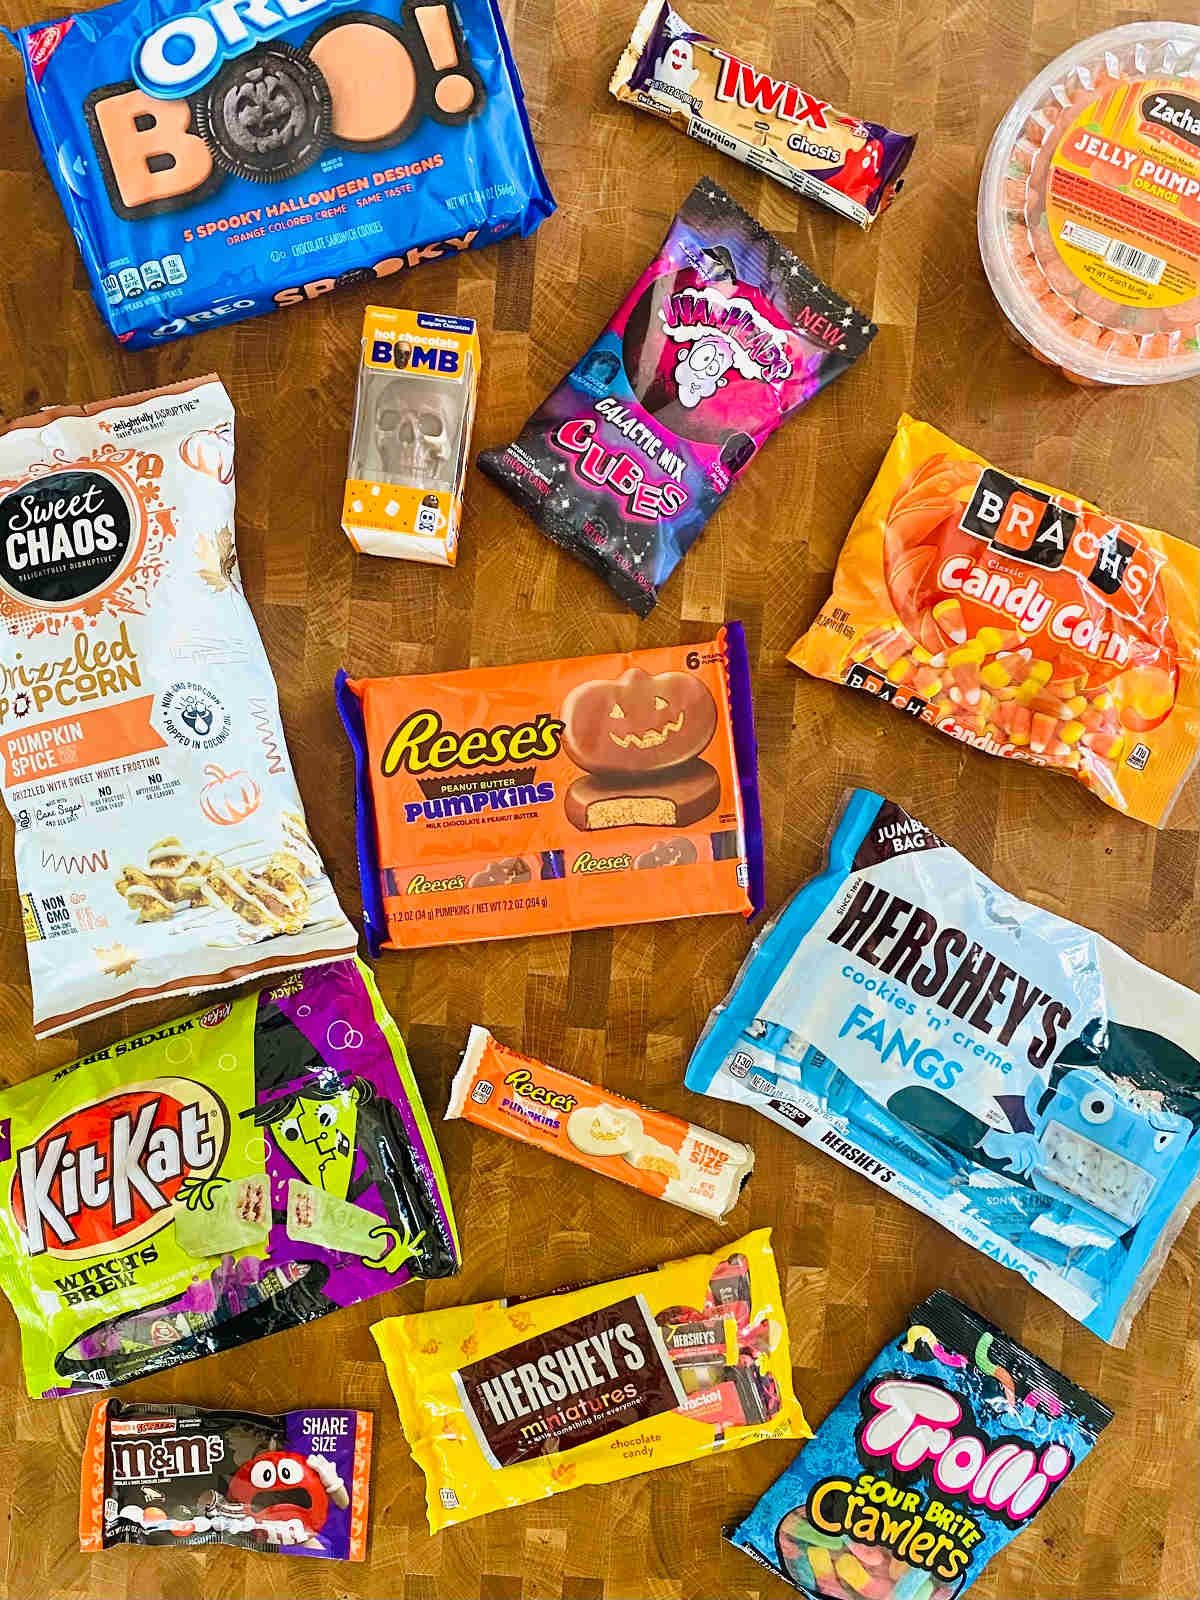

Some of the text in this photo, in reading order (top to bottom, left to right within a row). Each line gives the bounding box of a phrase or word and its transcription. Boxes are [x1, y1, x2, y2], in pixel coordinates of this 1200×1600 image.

[713, 48, 833, 132] TWIX
[692, 121, 737, 151] Nutrition
[787, 134, 841, 162] Ghosts
[1073, 133, 1138, 171] JELLY
[1139, 159, 1200, 202] PUMP
[183, 229, 194, 242] 5
[196, 208, 262, 239] SPOOKY
[266, 177, 369, 218] HALLOWEEN
[373, 154, 445, 187] DESIGNS
[356, 184, 414, 209] SAME TASTE
[1133, 178, 1179, 204] ORANGE
[226, 203, 347, 246] ORANGE COLORED CREME
[291, 221, 384, 257] CHOCOLATE SANDWICH COOKIES
[151, 299, 256, 337] OREO
[796, 304, 848, 347] NEW
[374, 328, 459, 349] hot chocolate
[371, 340, 459, 373] BOMB
[112, 411, 154, 432] delightfully
[593, 397, 688, 485] GALACTIC MIX
[553, 418, 689, 520] CUBES
[8, 484, 105, 532] Sweet
[976, 488, 1148, 597] BRACH'S
[987, 559, 1025, 578] Classic
[940, 556, 1130, 665] Candy Corn
[686, 651, 700, 670] 6
[7, 722, 84, 759] PUMPKIN
[162, 719, 191, 746] POPPED
[191, 740, 201, 750] IN
[202, 727, 230, 750] COCONUT
[381, 710, 565, 777] Reese's
[11, 748, 58, 778] SPICE
[12, 755, 161, 801] DRIZZLED WITH SWEET WHITE FROSTING
[98, 785, 112, 798] NO
[147, 773, 163, 785] NO
[441, 778, 516, 794] PEANUT BUTTER
[36, 804, 83, 822] Cane Sugar
[442, 817, 480, 828] CHOCOLATE
[486, 814, 513, 823] PEANUT
[513, 811, 540, 820] BUTTER
[891, 832, 926, 853] BAG
[572, 852, 632, 874] Reese's
[407, 874, 465, 895] Reese's
[41, 895, 66, 911] NON
[46, 908, 70, 924] GMO
[404, 911, 414, 922] OZ
[415, 910, 426, 922] (34
[434, 904, 470, 920] PUMPKINS
[476, 901, 488, 914] NET
[488, 900, 501, 913] WT
[514, 898, 524, 910] OZ
[836, 892, 852, 915] SINCE
[827, 880, 1073, 1070] HERSHEY'S
[841, 964, 918, 1017] cookies
[952, 1030, 1014, 1076] creme
[837, 1002, 965, 1091] FANGS
[735, 1055, 751, 1069] 130
[504, 1069, 579, 1114] Reese's
[751, 1073, 764, 1089] NET
[688, 1151, 725, 1170] SIZE
[693, 1140, 730, 1163] KING
[819, 1130, 896, 1185] HERSHEY'S
[18, 1100, 216, 1258] KitKat
[54, 1242, 160, 1294] WITCH'S
[57, 1269, 143, 1307] BREW
[672, 1330, 716, 1348] HERSHEY'S
[89, 1370, 106, 1381] 140
[479, 1322, 646, 1426] HERSHEY'S
[302, 1416, 348, 1436] SHARE
[519, 1382, 638, 1440] miniatures
[552, 1416, 594, 1437] something
[593, 1411, 605, 1421] for
[311, 1436, 338, 1453] SIZE
[610, 1432, 662, 1450] chocolate
[622, 1446, 655, 1460] candy
[862, 1380, 1072, 1521] Trolli
[855, 1475, 921, 1513] SOUR
[810, 1479, 969, 1579] Crawlers
